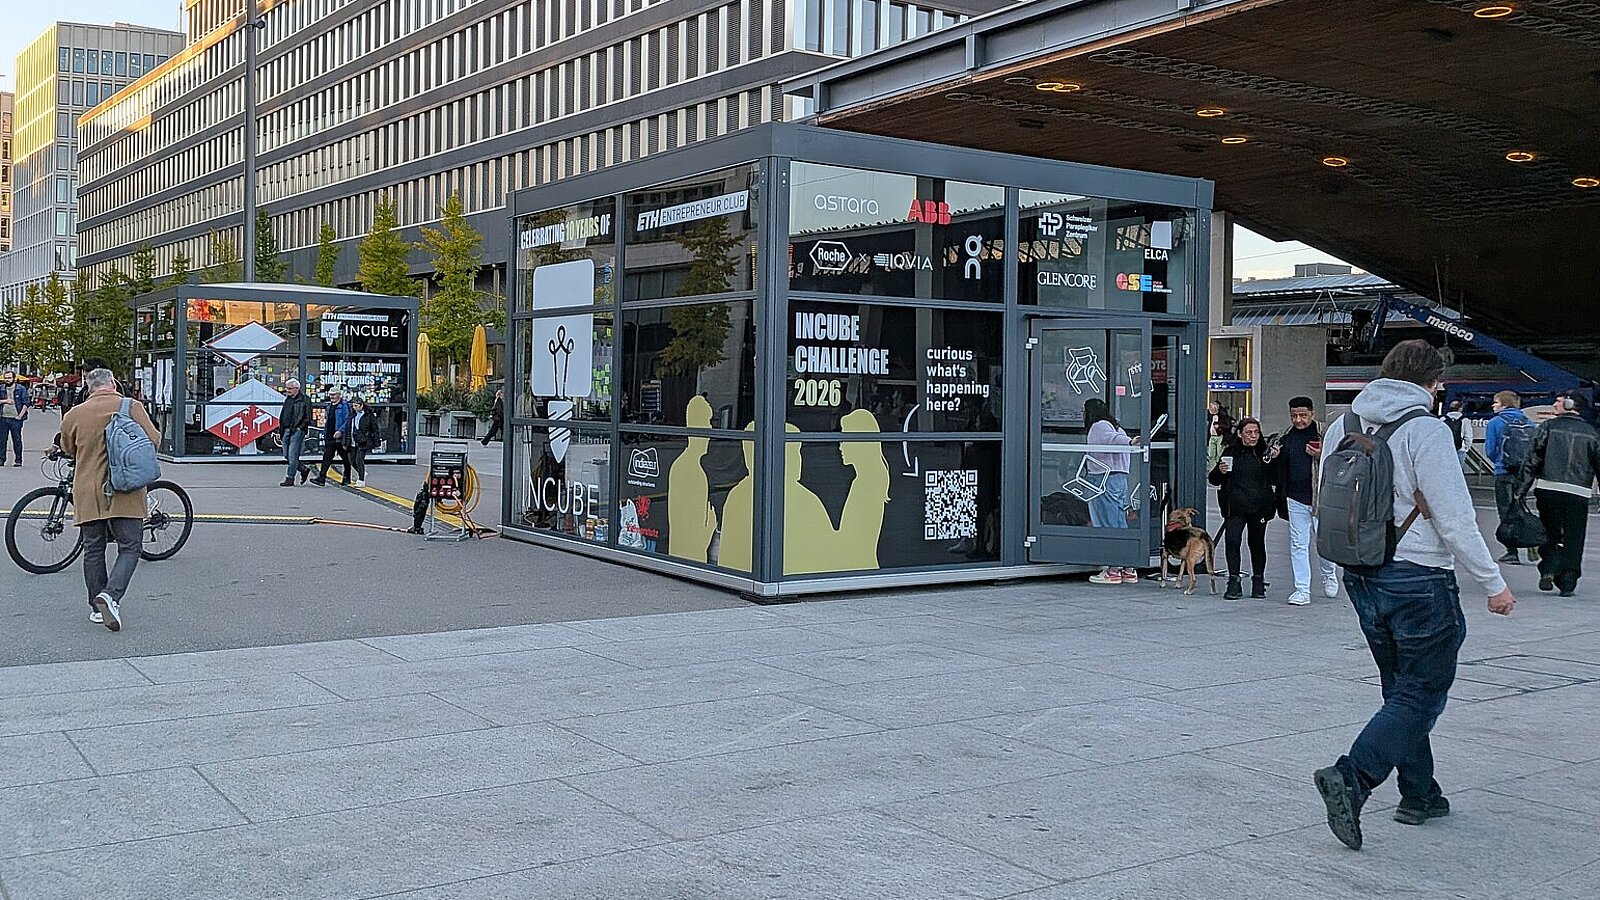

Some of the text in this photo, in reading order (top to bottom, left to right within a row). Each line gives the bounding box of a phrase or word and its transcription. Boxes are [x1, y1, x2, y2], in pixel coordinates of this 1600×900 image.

[637, 195, 745, 231] ETH ENTREPRENEUR CLUB
[908, 198, 951, 225] ABB
[1065, 214, 1092, 223] Schweizer
[520, 214, 611, 250] CELEBRATING 10 YEARS OF
[1065, 230, 1088, 239] Zentrum
[817, 246, 846, 262] Roche
[889, 253, 934, 271] IQVIA
[1144, 249, 1169, 261] ELCA
[1037, 271, 1096, 291] GLENCORE
[345, 324, 399, 338] INCUBE
[795, 312, 860, 341] INCUBE
[1426, 315, 1474, 341] mateco
[794, 345, 889, 375] CHALLENGE
[927, 346, 973, 360] curious
[320, 361, 401, 373] BIG IDEAS START WITH
[926, 363, 967, 377] what's
[320, 374, 346, 385] SIMPLE
[926, 380, 990, 398] happening
[794, 379, 842, 407] 2026
[926, 398, 961, 412] here?
[522, 475, 599, 519] INCUBE
